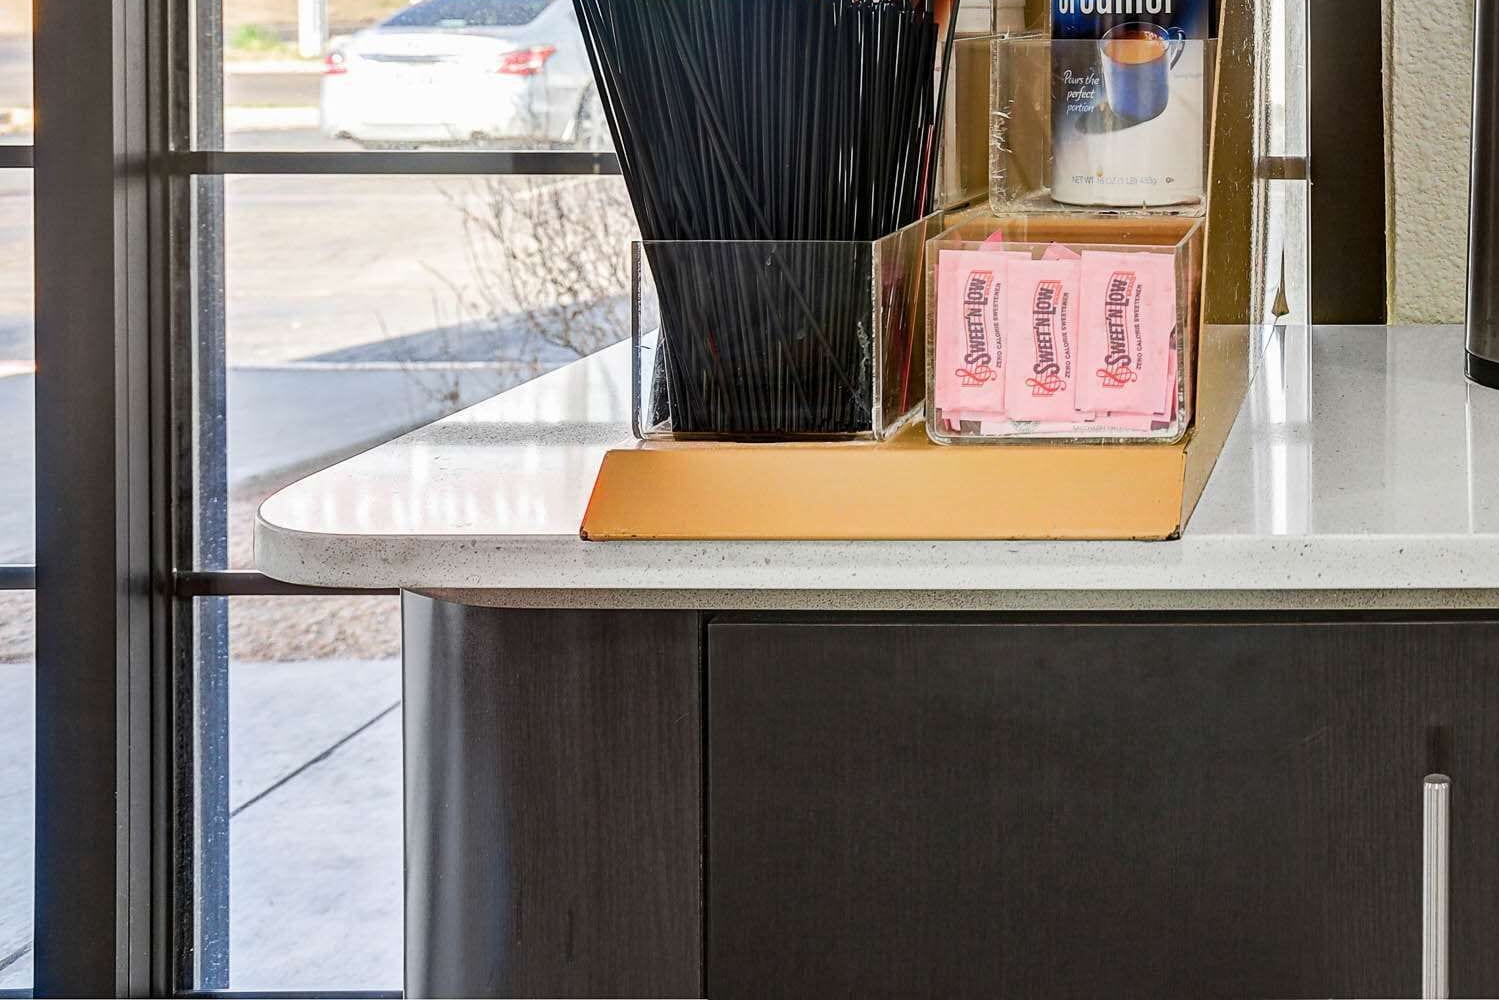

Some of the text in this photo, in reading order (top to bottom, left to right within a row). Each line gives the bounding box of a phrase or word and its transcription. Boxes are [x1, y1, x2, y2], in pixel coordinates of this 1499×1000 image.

[1063, 69, 1100, 86] Pours the
[1066, 86, 1096, 102] perfect
[1066, 102, 1096, 116] portion
